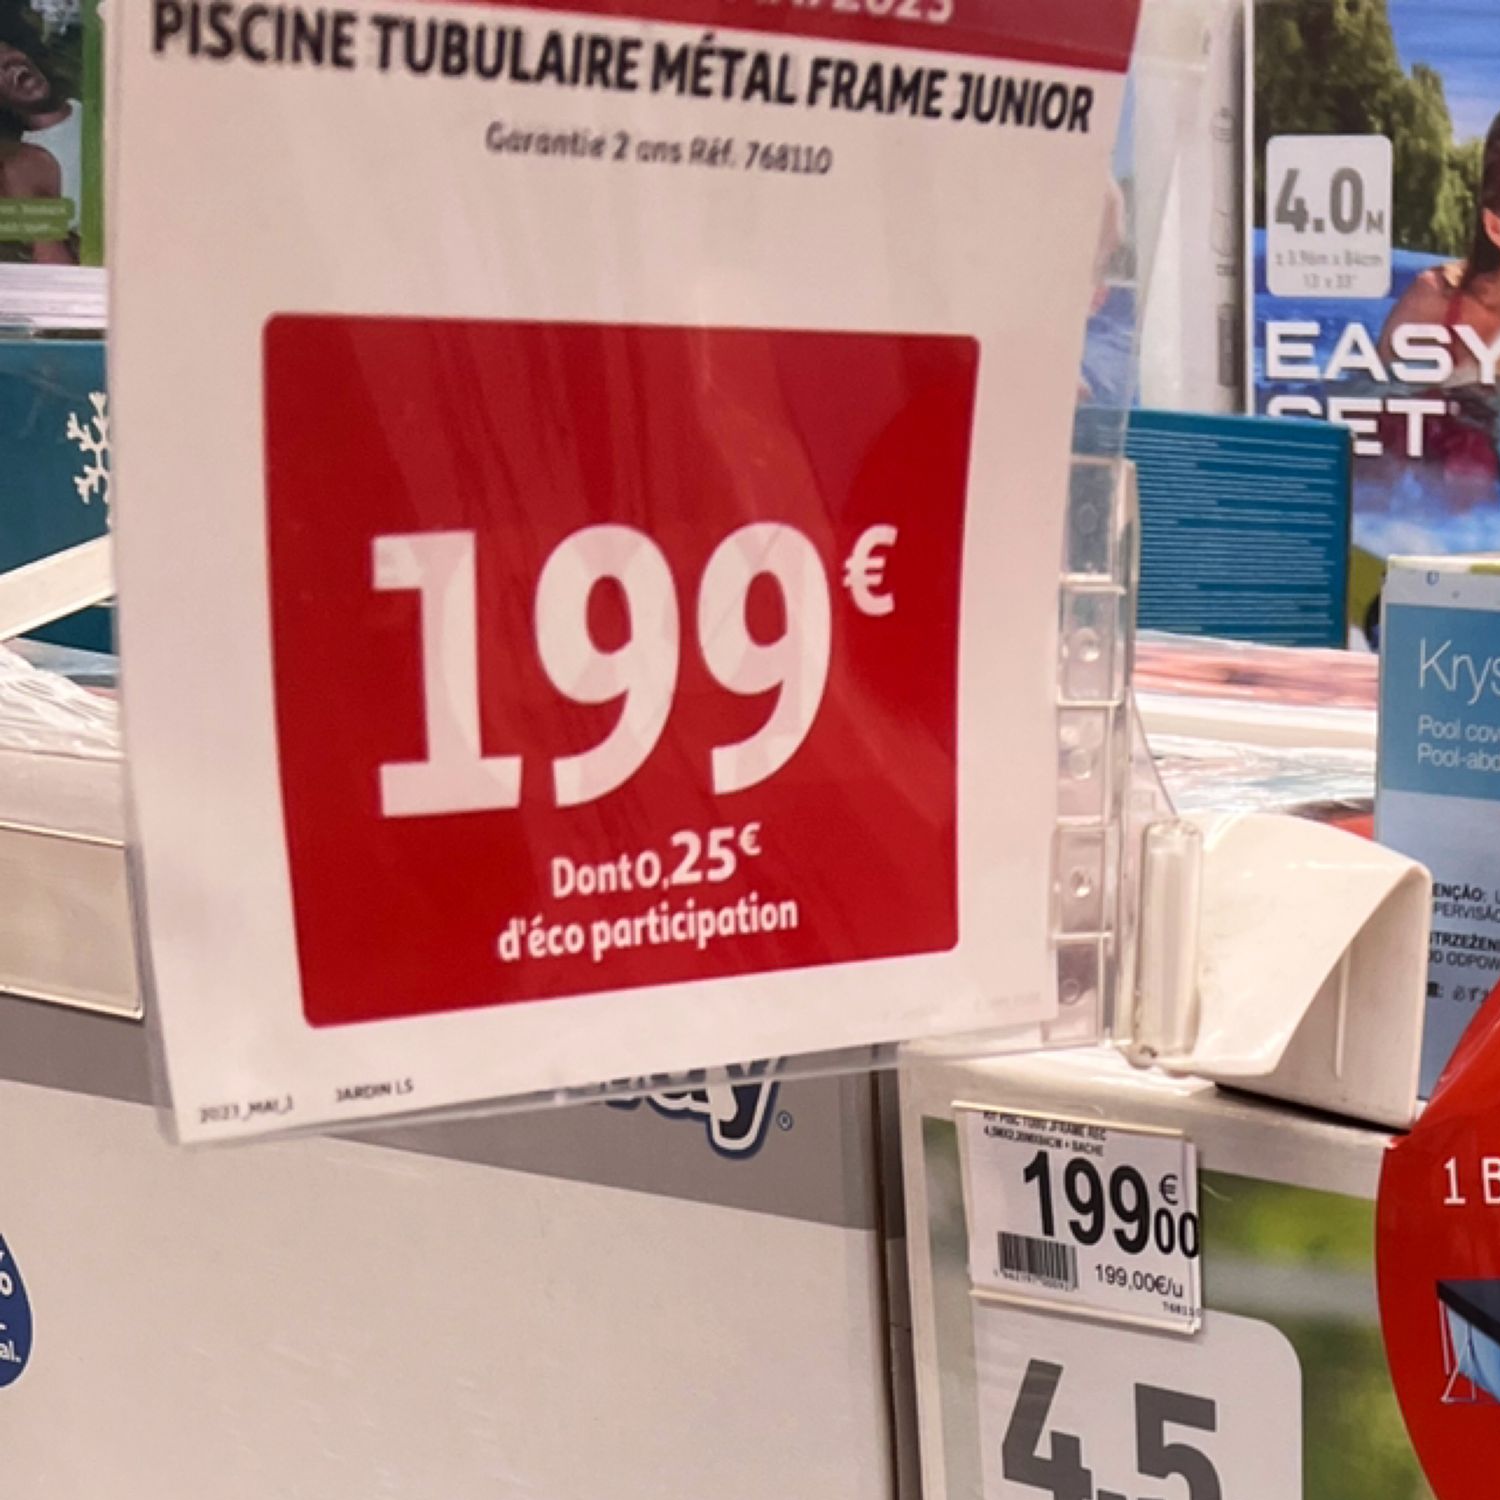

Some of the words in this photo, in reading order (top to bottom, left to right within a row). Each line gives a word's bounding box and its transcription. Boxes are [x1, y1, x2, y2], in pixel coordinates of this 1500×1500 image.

[152, 1, 357, 68] PISCINE
[371, 14, 643, 92] TUBULAIRE
[651, 33, 797, 106] MÉTAL
[807, 57, 946, 119] FRAME
[951, 72, 1095, 133] JUNIOR
[485, 121, 607, 159] Garantie
[612, 130, 630, 161] 2
[636, 138, 683, 165] ans
[744, 141, 834, 175] 768110
[1268, 396, 1445, 457] ET
[1418, 715, 1460, 739] Pool
[551, 852, 633, 898] Dont
[1432, 883, 1485, 902] ENÇÃO:
[498, 912, 585, 963] d'éco
[590, 891, 799, 963] participation
[1443, 1158, 1466, 1206] 1
